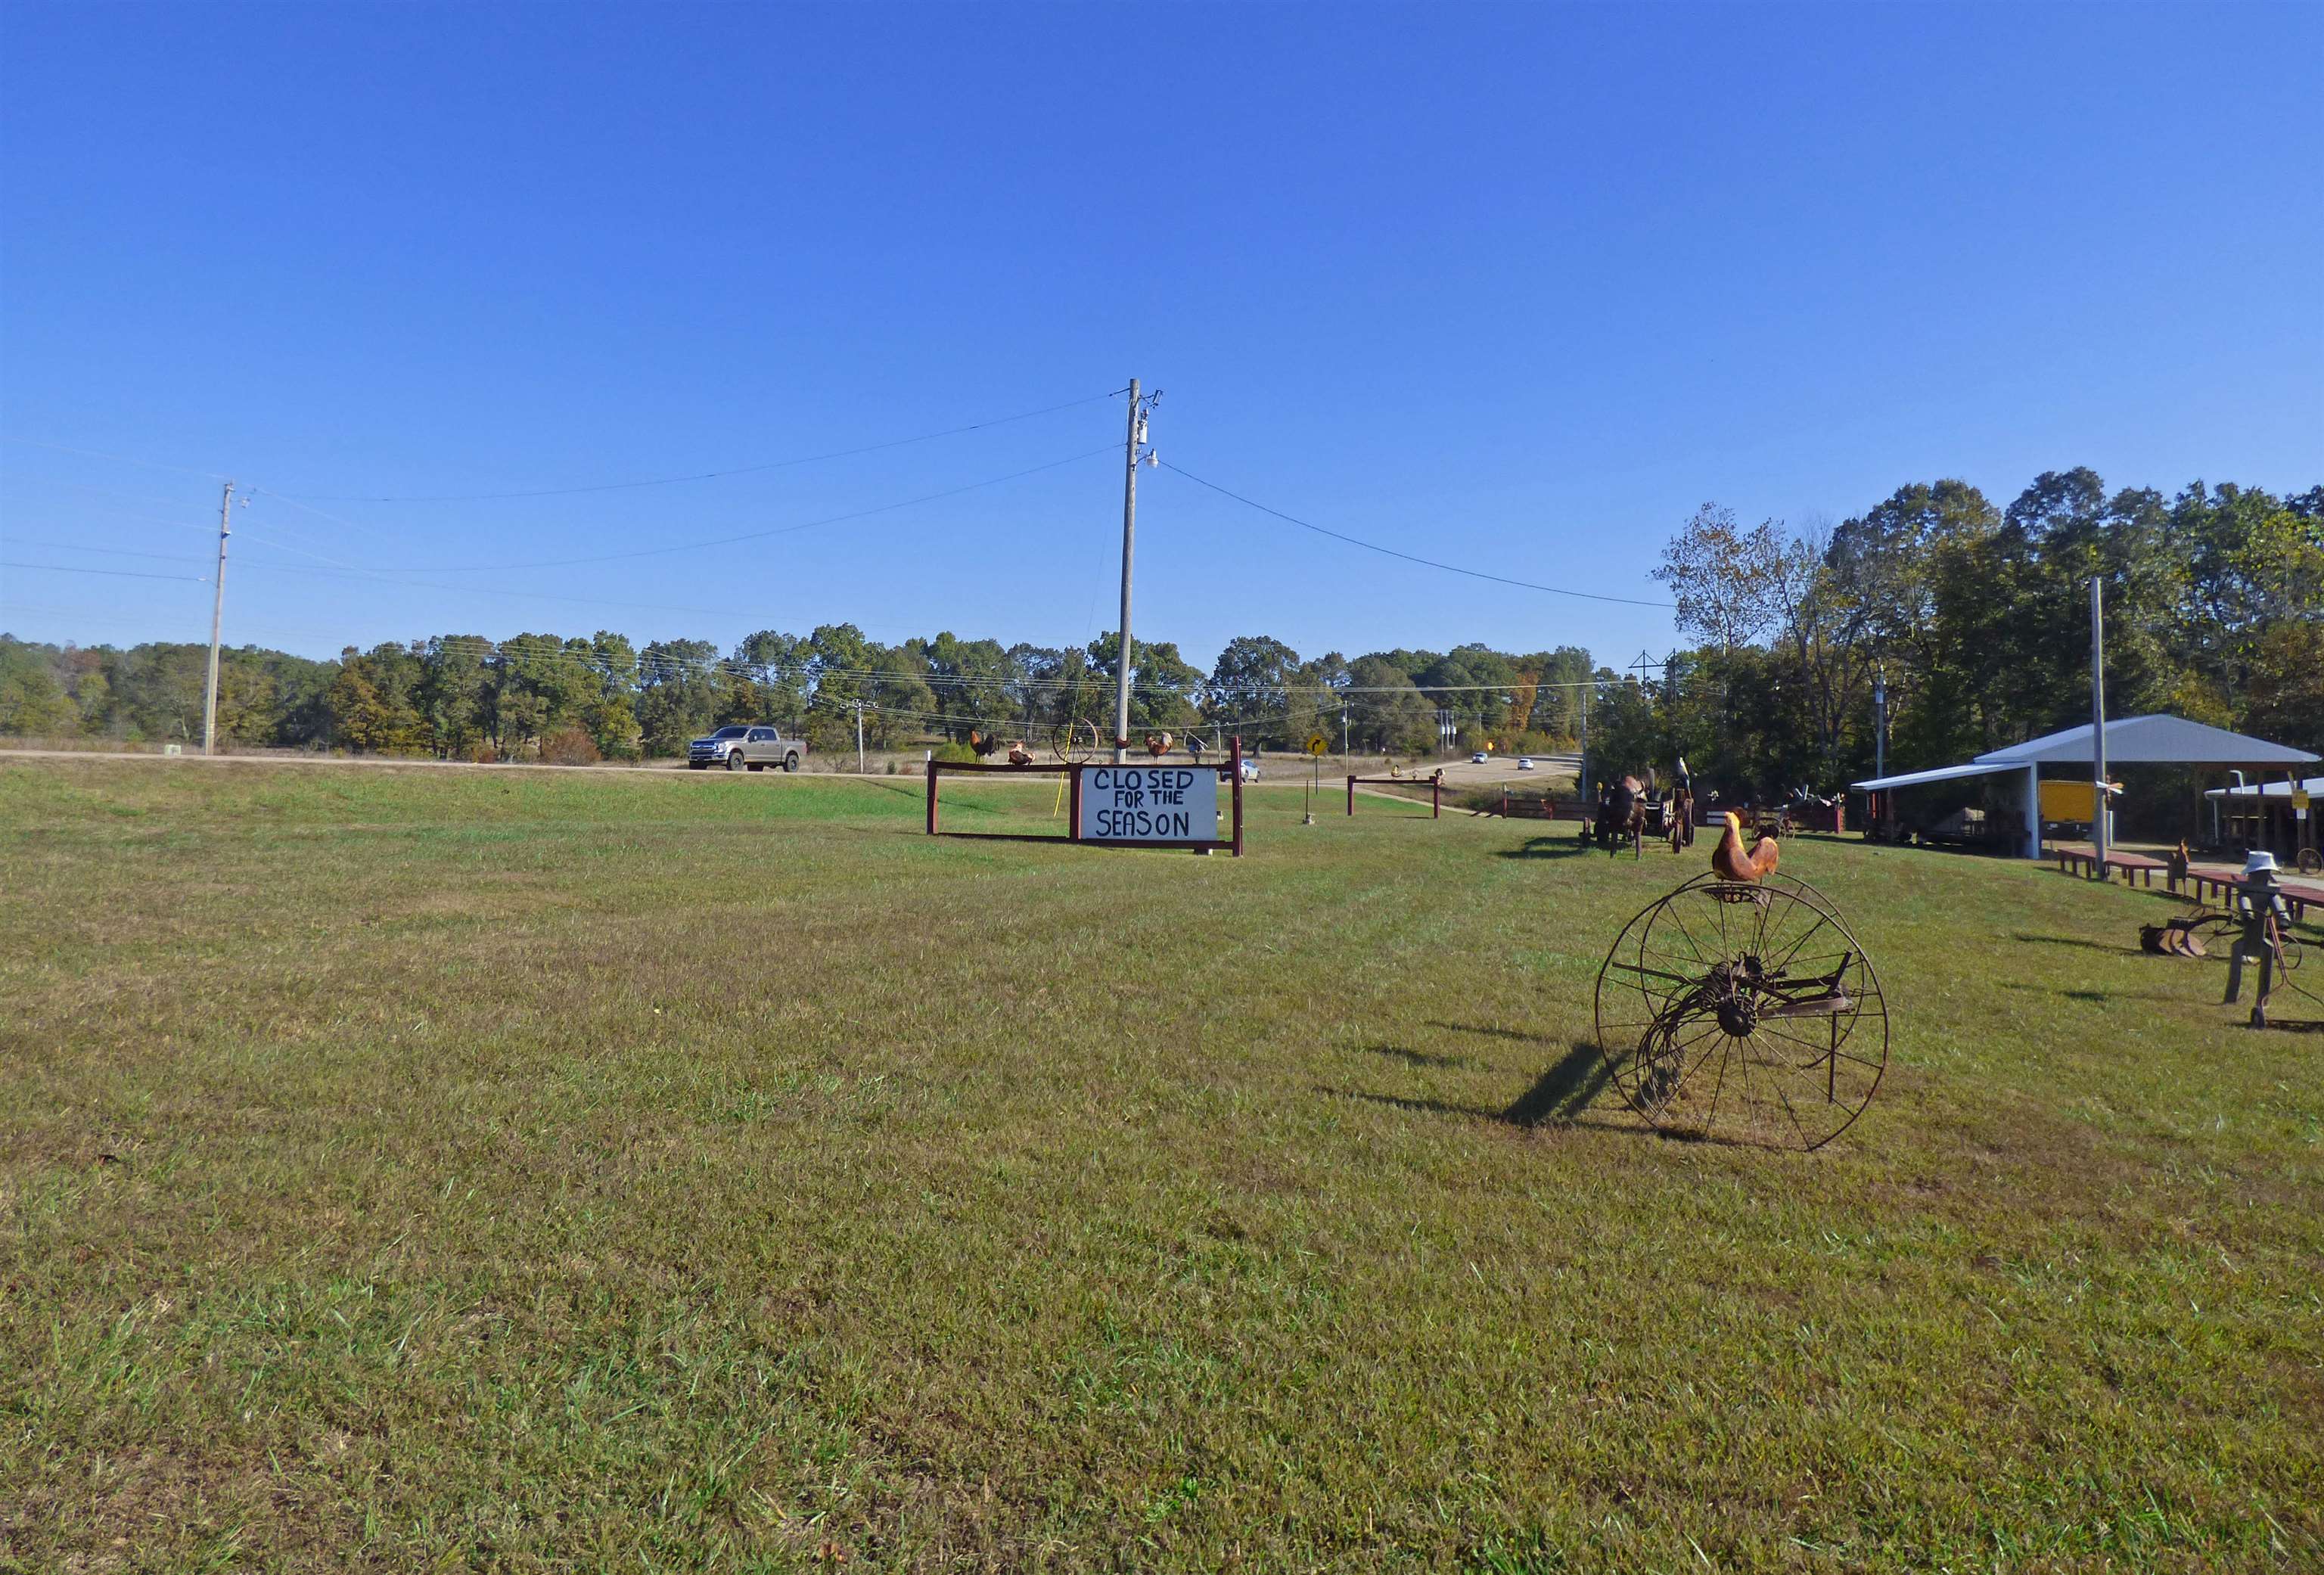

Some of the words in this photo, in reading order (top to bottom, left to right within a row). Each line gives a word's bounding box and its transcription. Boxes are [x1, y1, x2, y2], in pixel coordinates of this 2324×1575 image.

[1095, 769, 1194, 790] CLOSED
[1114, 791, 1144, 808] FOR
[1150, 791, 1184, 805] THE
[1096, 809, 1189, 837] SEASON
